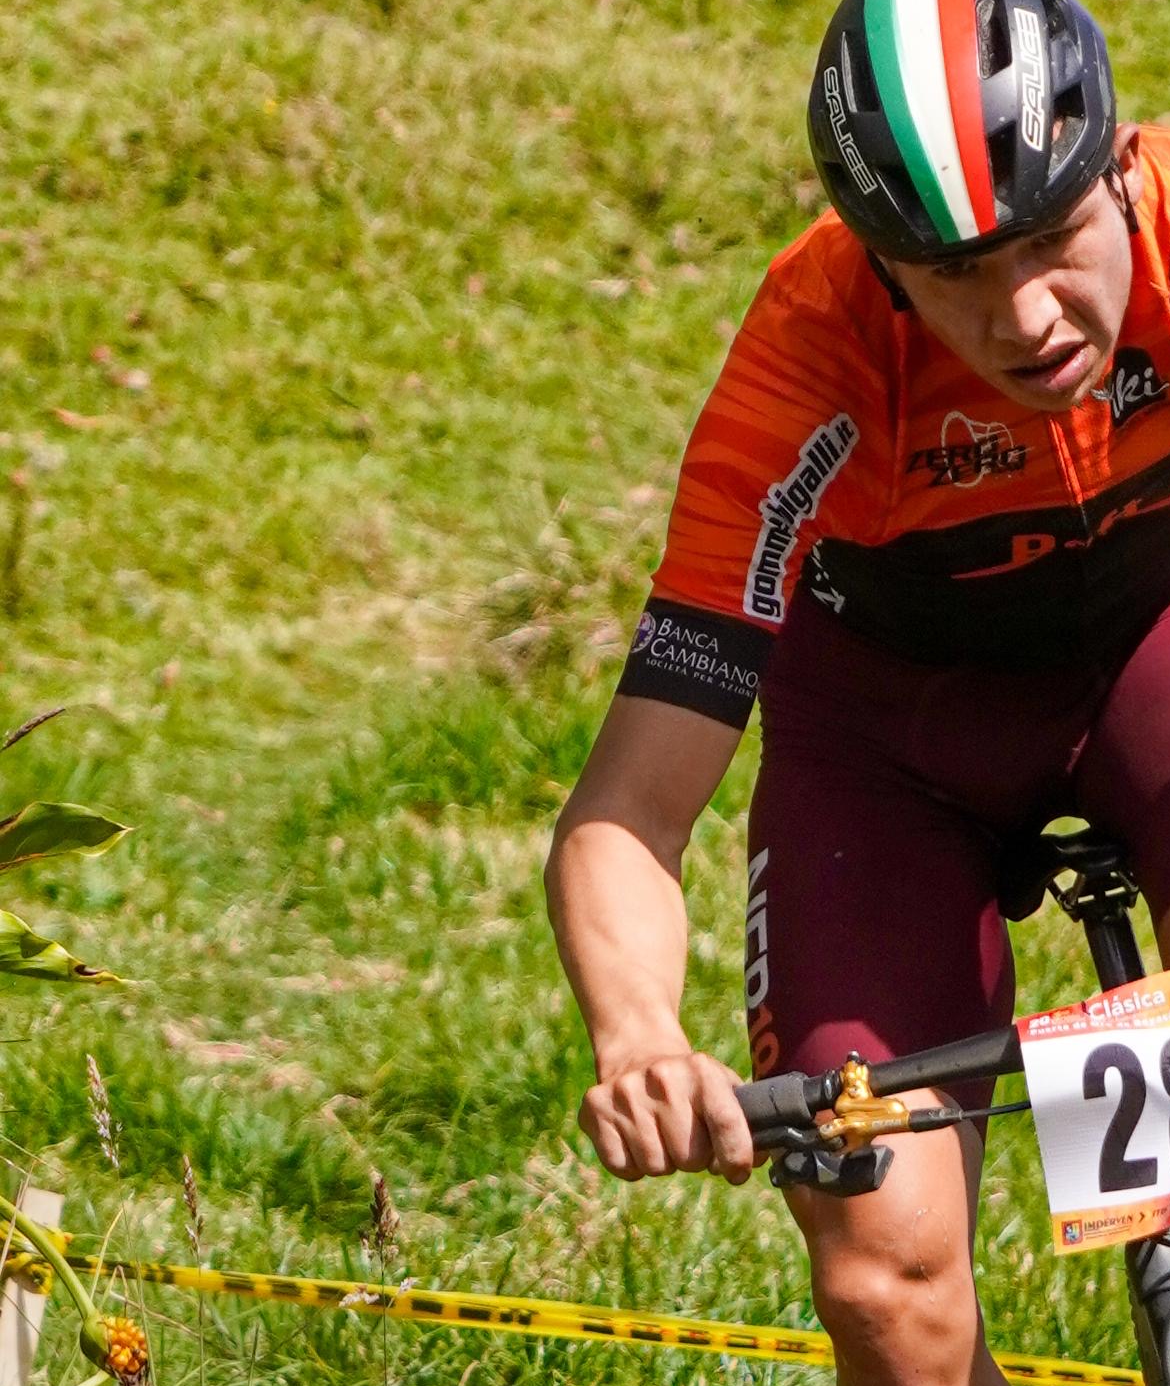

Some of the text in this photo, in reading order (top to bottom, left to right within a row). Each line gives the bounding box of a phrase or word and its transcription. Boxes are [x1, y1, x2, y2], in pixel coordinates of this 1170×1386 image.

[1013, 7, 1044, 151] SALICE
[824, 67, 878, 195] SALICE
[658, 618, 720, 652] BANCA
[650, 637, 759, 688] CAMBIANO
[1089, 987, 1166, 1021] Clásica
